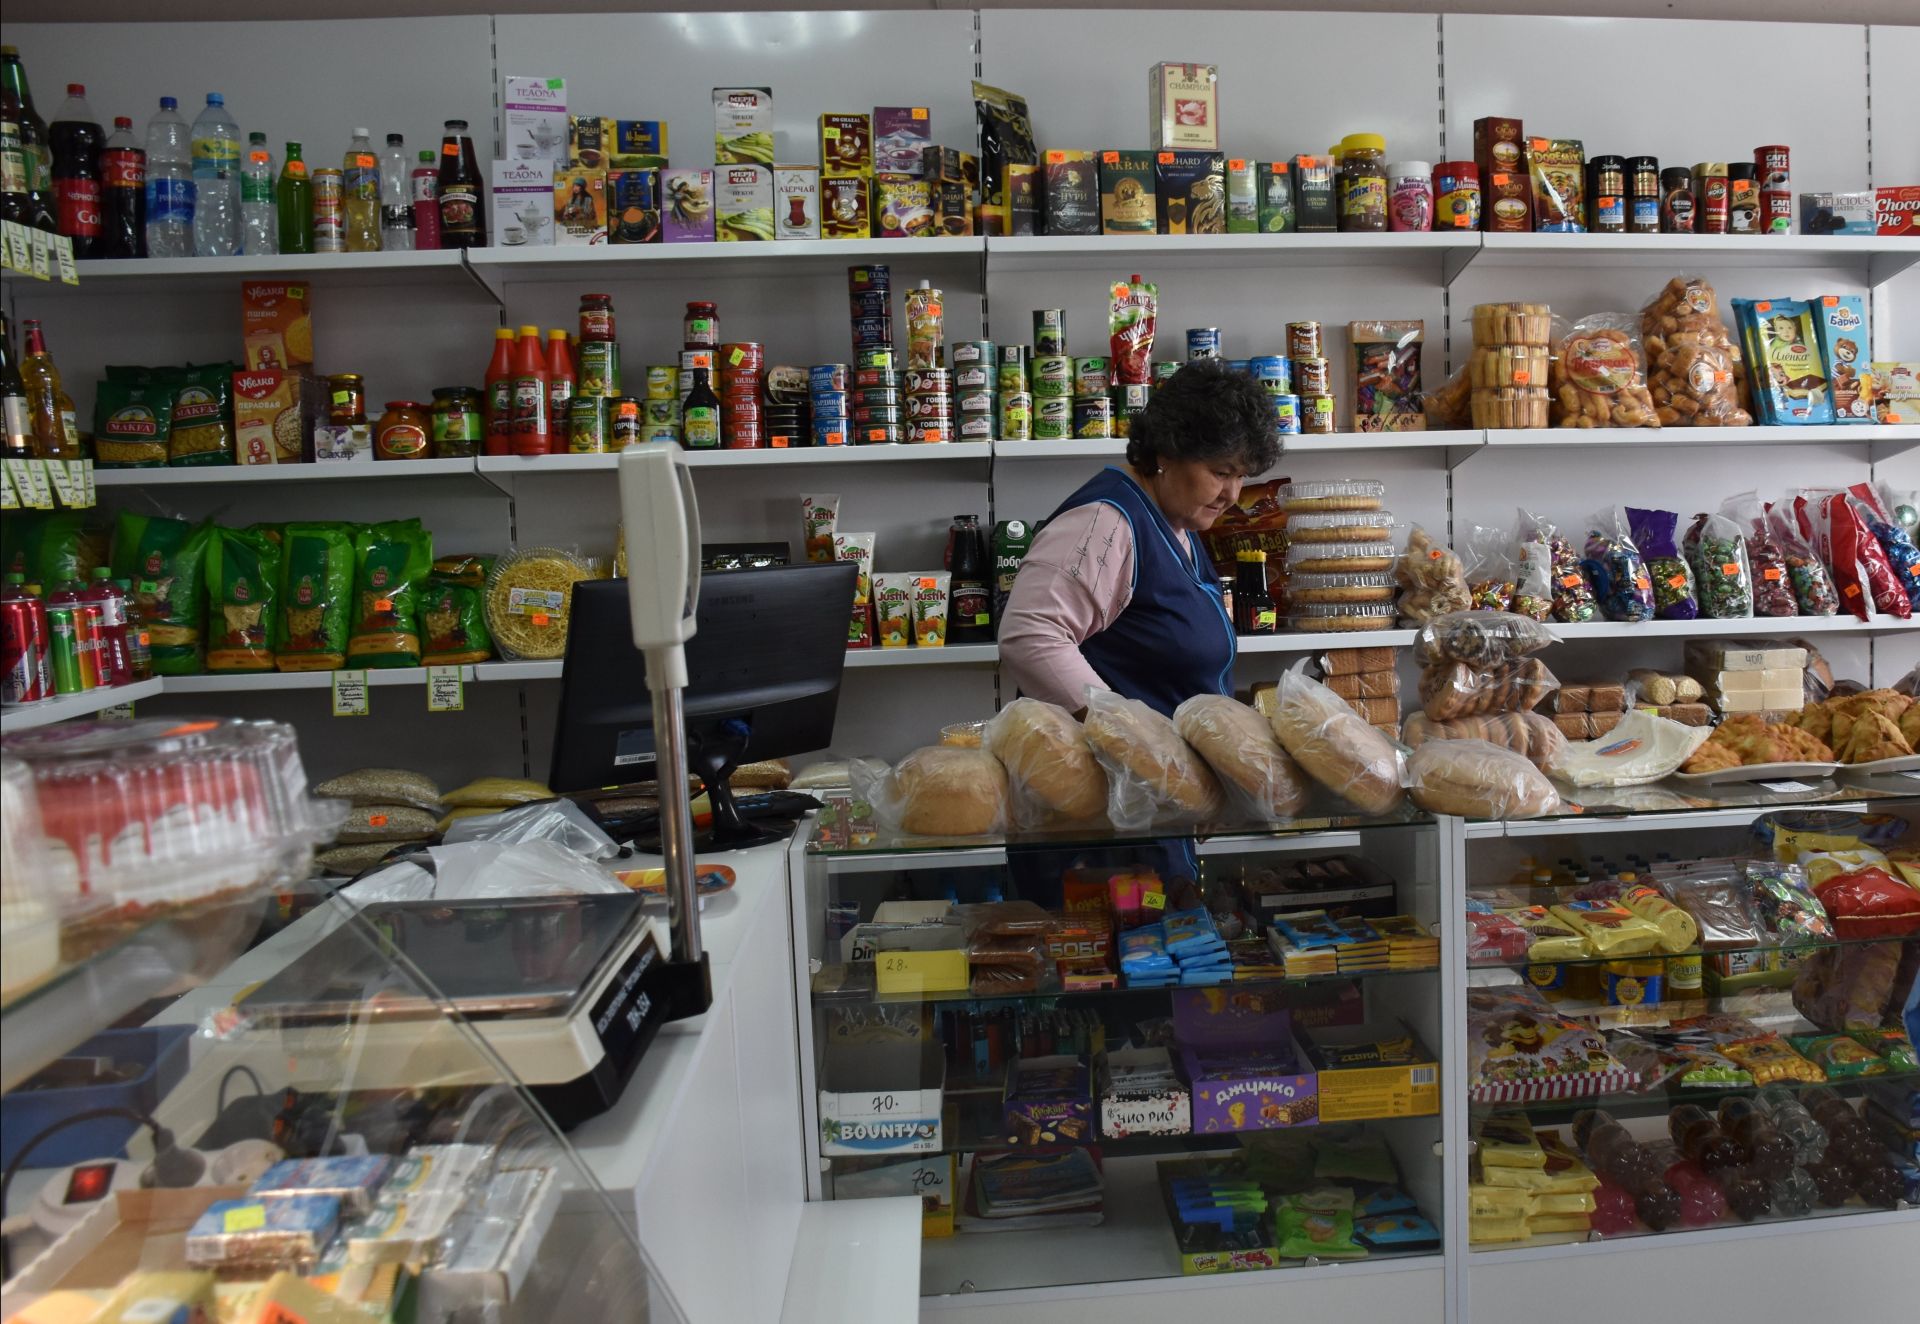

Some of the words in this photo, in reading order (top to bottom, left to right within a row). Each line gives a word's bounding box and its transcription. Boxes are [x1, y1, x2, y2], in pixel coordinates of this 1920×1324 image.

[1169, 82, 1211, 92] CHAMPION
[515, 88, 557, 99] TEAONA
[1106, 160, 1151, 171] AKBAR
[502, 171, 544, 181] TEAONA
[778, 183, 816, 194] АЗЕРЧАЙ
[1815, 196, 1871, 207] DELICIOUS
[1876, 198, 1920, 213] Choco
[1876, 213, 1903, 228] Pie
[247, 310, 279, 320] ПШЕНО
[1829, 315, 1862, 329] Барни
[239, 376, 275, 391] Увелка
[238, 400, 281, 411] ПЕРЛОВАЯ
[107, 422, 152, 434] MAKFA
[252, 441, 261, 451] 5
[317, 448, 355, 462] Сахар
[806, 509, 837, 521] Justik
[838, 547, 870, 562] Justik
[878, 590, 911, 603] Justik
[914, 589, 946, 603] Justik
[1214, 1080, 1295, 1107] ДЖУМКА
[1116, 1111, 1146, 1124] ЧИО
[1147, 1110, 1174, 1124] РИО
[840, 1122, 918, 1142] BOUNTY
